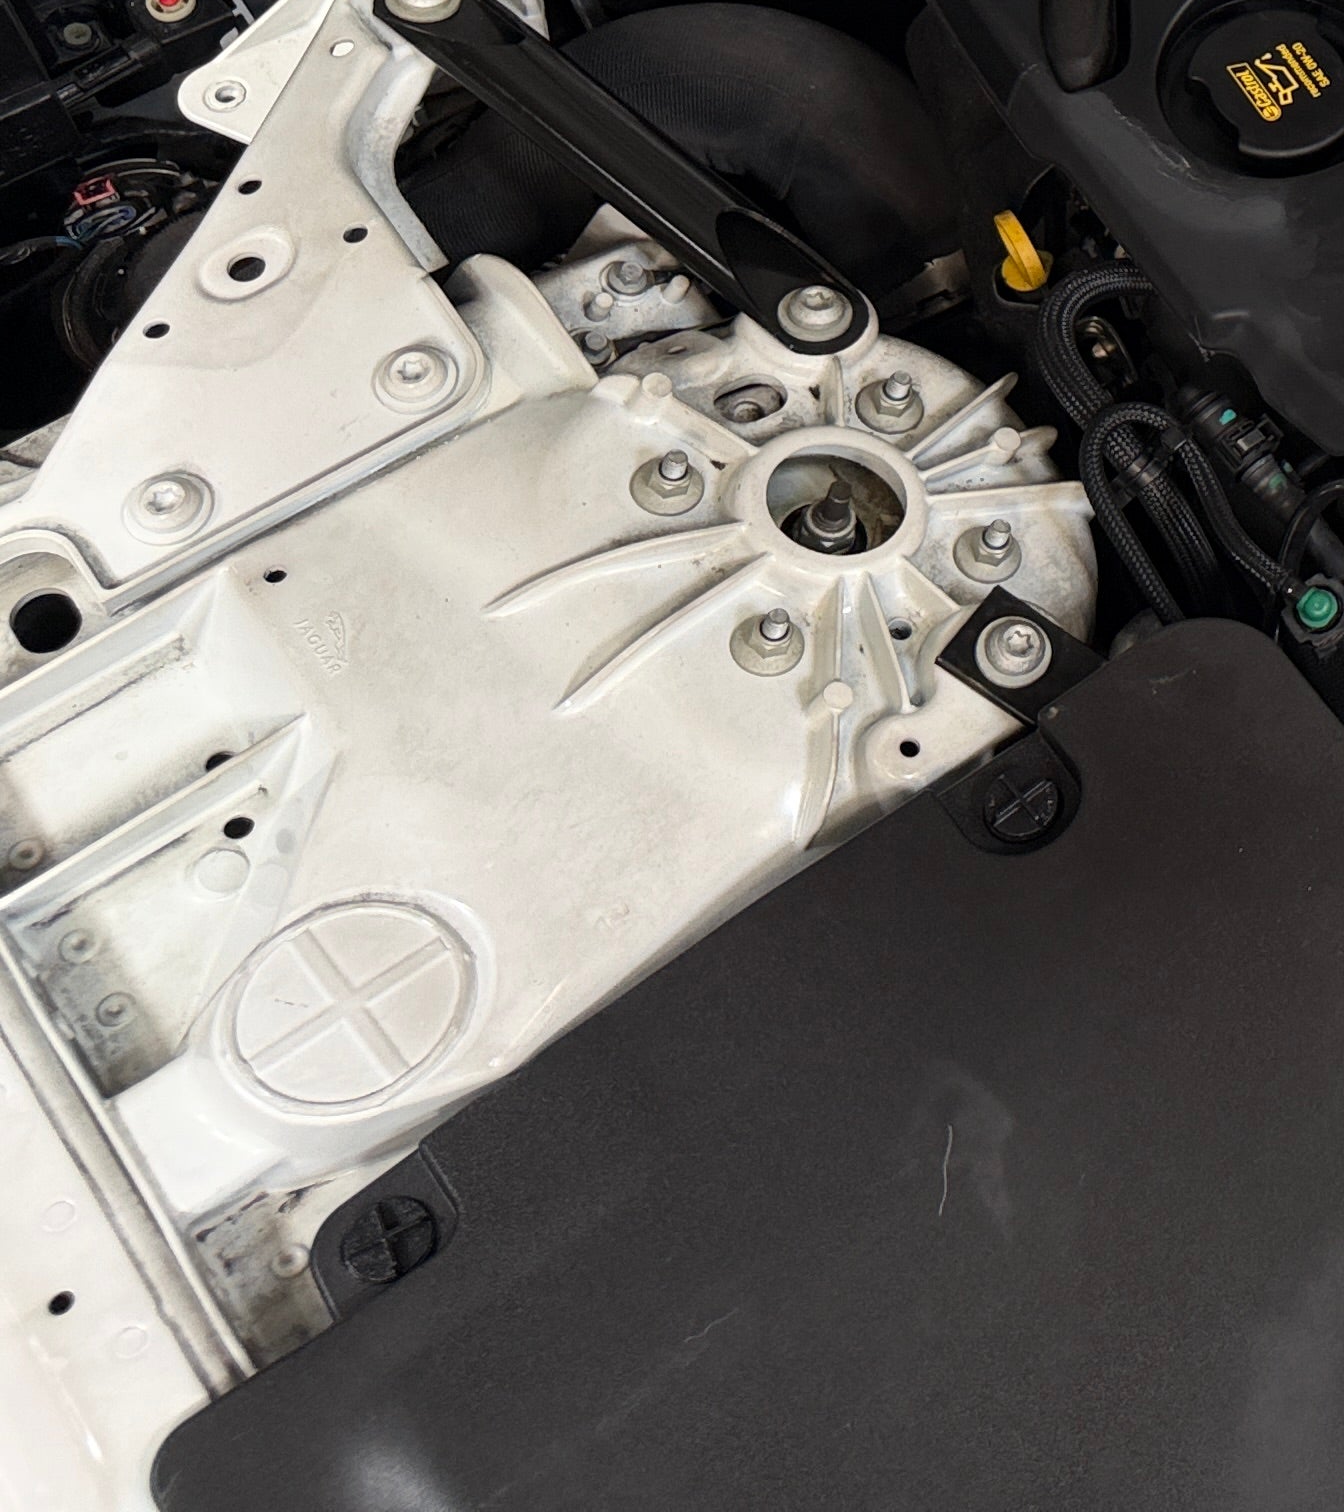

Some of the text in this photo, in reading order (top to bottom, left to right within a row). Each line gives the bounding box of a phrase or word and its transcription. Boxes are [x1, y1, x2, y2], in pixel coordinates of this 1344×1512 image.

[1235, 69, 1272, 109] Castrol
[1275, 43, 1322, 99] recommended
[1312, 68, 1331, 89] SAE
[292, 618, 342, 675] JAGUAR
